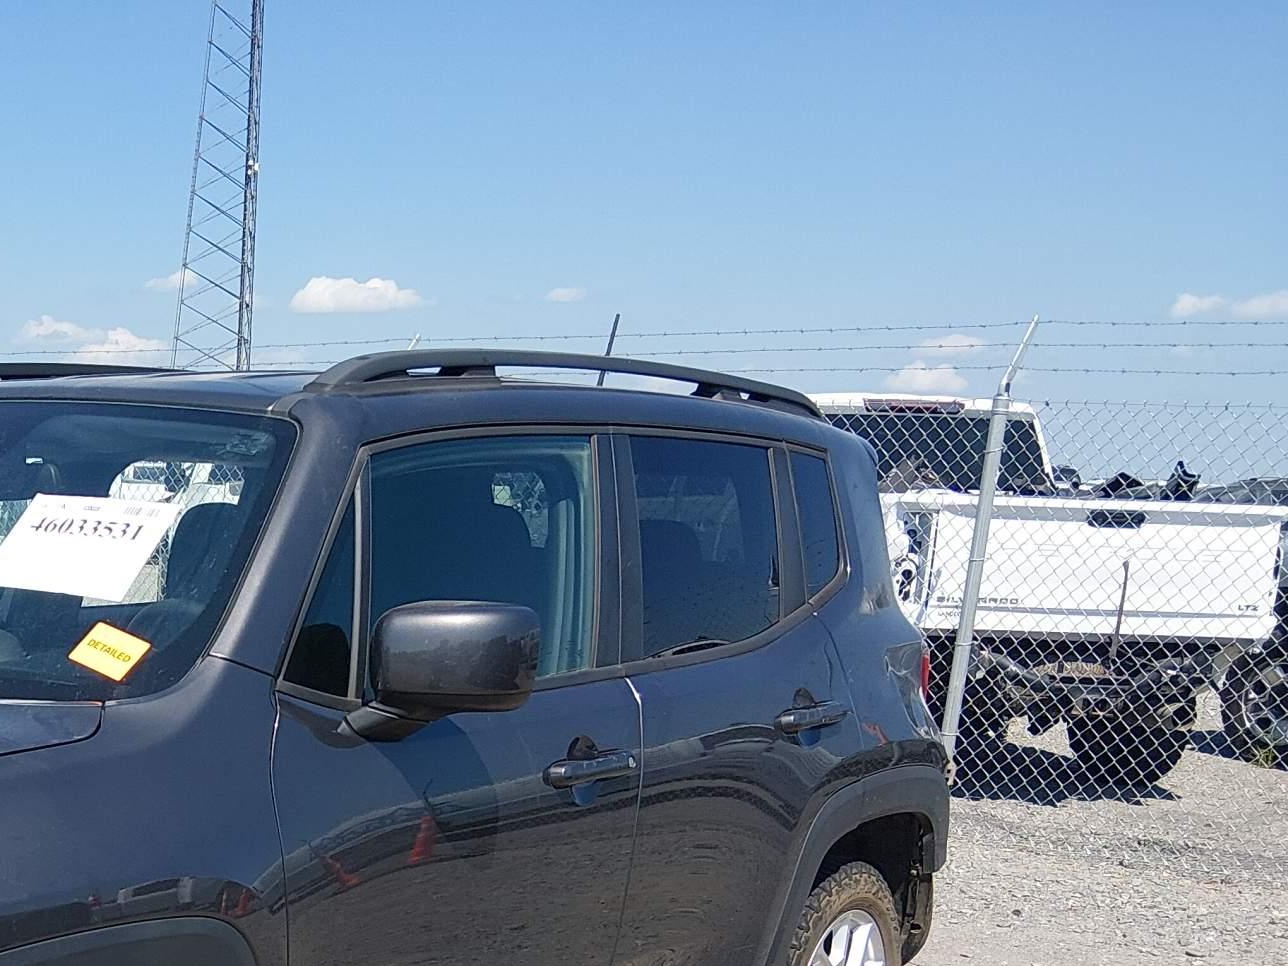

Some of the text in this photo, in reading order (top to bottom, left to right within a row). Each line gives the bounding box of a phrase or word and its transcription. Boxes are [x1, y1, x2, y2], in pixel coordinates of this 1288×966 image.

[31, 517, 144, 540] 46033531
[936, 596, 1019, 605] SILVRADO
[1238, 604, 1260, 612] LTZ
[87, 638, 132, 663] DETAILED
